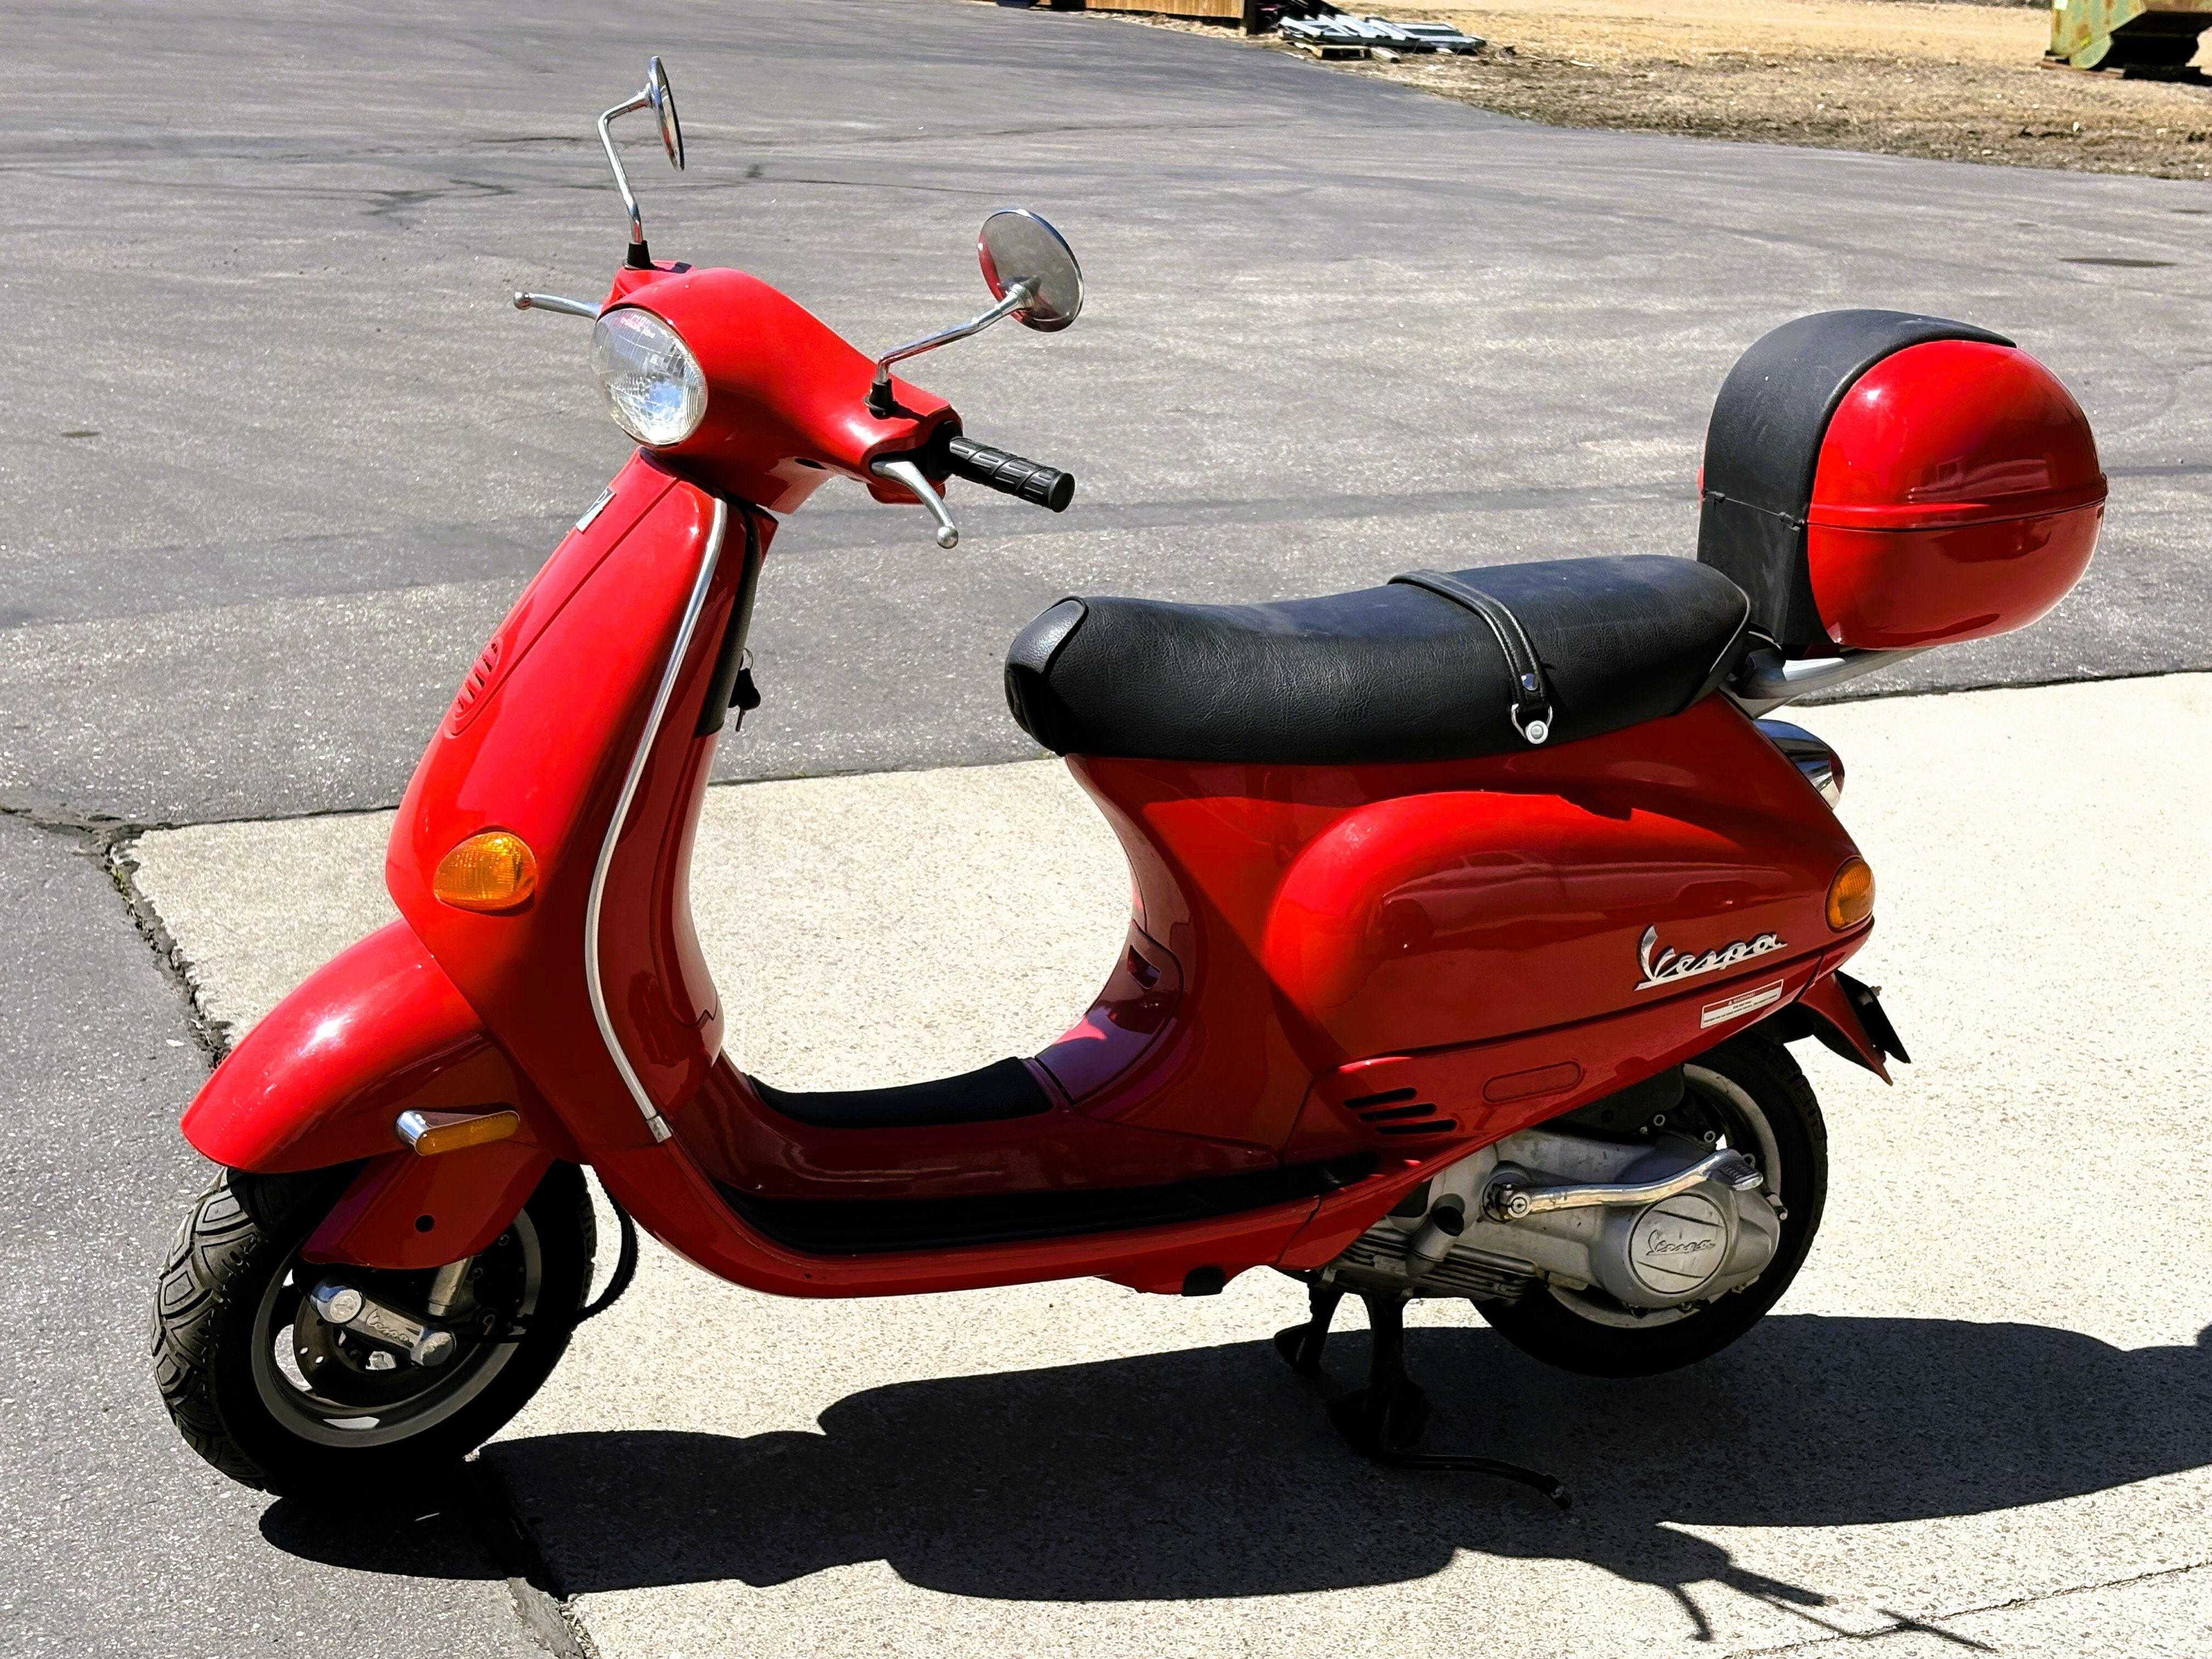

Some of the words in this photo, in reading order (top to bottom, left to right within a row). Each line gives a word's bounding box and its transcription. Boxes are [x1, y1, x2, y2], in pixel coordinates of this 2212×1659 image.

[1634, 924, 1788, 991] Vespa
[1646, 1230, 1717, 1256] Vespa
[366, 1308, 414, 1347] Vespa
